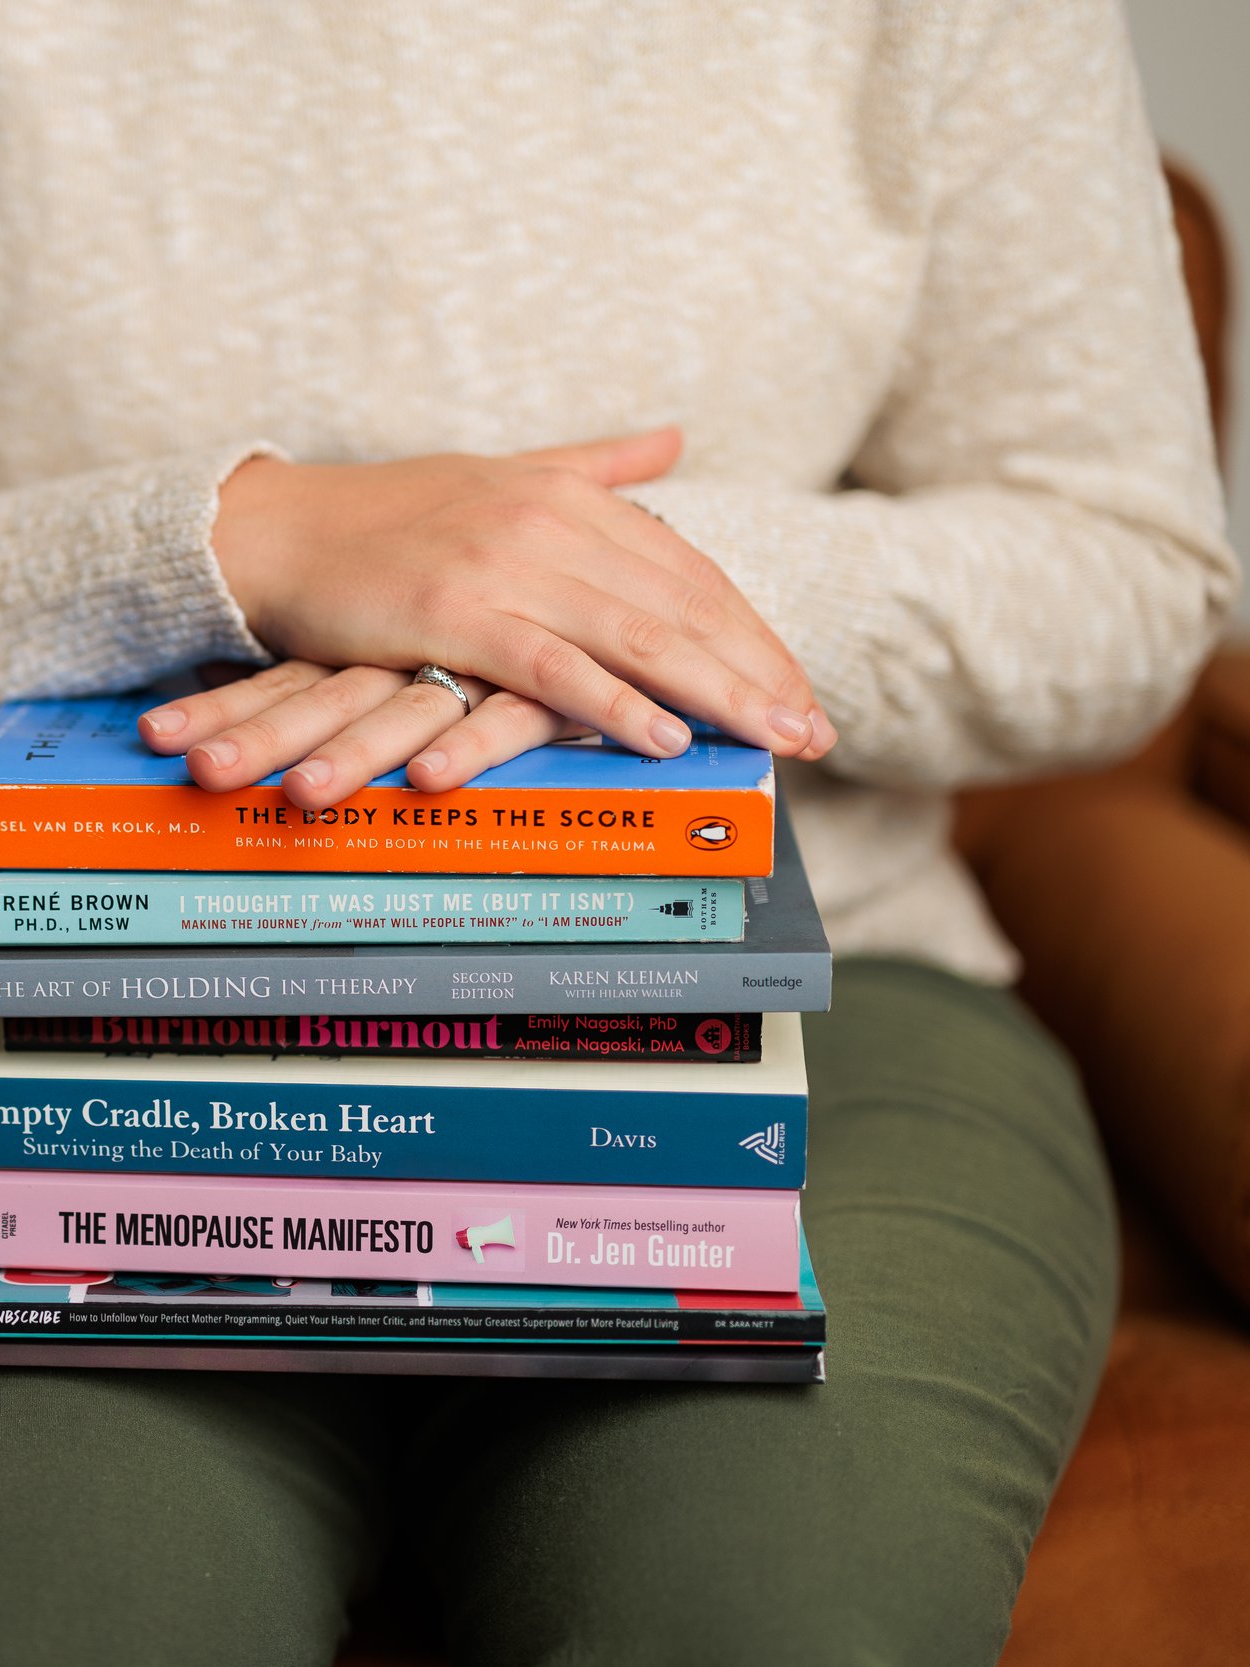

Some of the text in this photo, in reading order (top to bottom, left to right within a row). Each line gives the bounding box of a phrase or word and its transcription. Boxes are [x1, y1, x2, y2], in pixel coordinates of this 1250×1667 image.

[235, 807, 655, 828] THE BODY KEEPS THE SCORE
[33, 821, 67, 833] VAN
[73, 821, 105, 833] DER
[112, 822, 161, 835] KOLK,
[168, 822, 206, 834] M.D.
[235, 837, 656, 851] BRAIN, MIND, AND BODY IN THE HEALING OF TRAUMA
[71, 894, 149, 911] BROWN
[179, 895, 185, 913] I
[194, 894, 292, 913] THOUGHT
[301, 895, 320, 912] IT
[328, 894, 375, 913] WAS
[384, 893, 434, 912] JUST
[443, 893, 473, 912] ME
[482, 892, 533, 913] (BUT
[542, 892, 561, 911] IT
[15, 917, 130, 933] PH.D., LMSW
[181, 919, 227, 930] MAKING
[231, 919, 253, 929] THE
[257, 919, 308, 930] JOURNEY
[310, 918, 343, 931] from
[391, 918, 418, 928] WILL
[422, 917, 465, 928] PEOPLE
[522, 917, 534, 927] to
[552, 916, 571, 927] AM
[452, 972, 513, 984] SECOND
[549, 970, 699, 985] KAREN KLEIMAN
[742, 976, 803, 990] Routledge
[32, 981, 75, 997] ART
[82, 980, 111, 997] OF
[120, 976, 271, 999] HOLDING
[281, 979, 306, 995] IN
[314, 978, 418, 995] THERAPY
[451, 988, 515, 999] EDITION
[565, 989, 683, 999] WITH HILARY WALLER
[89, 1016, 293, 1047] Burnout
[296, 1014, 503, 1050] Burnout
[527, 1015, 677, 1033] Emily Nagoski, PhD
[514, 1036, 685, 1055] Amelia Nagoski, DMA
[82, 1098, 200, 1136] Cradle,
[209, 1101, 329, 1132] Broken
[338, 1104, 436, 1135] Heart
[778, 1122, 786, 1165] FULCRUM
[23, 1137, 383, 1169] Surviving the Death of Your Baby
[1, 1211, 9, 1240] CITADEL
[9, 1214, 17, 1237] PRESS
[58, 1211, 434, 1254] THE MENOPAUSE MANIFESTO
[555, 1217, 726, 1235] New York Times bestselling author
[547, 1231, 735, 1269] Dr. Jen Gunter
[69, 1312, 679, 1331] How to Unfollow Your Perfect Mother Programming, Quiet Your Harsh Inner Critic, and Harness Your Greatest Superpower for More Peaceful Living
[715, 1320, 775, 1329] DR SARA NETT
